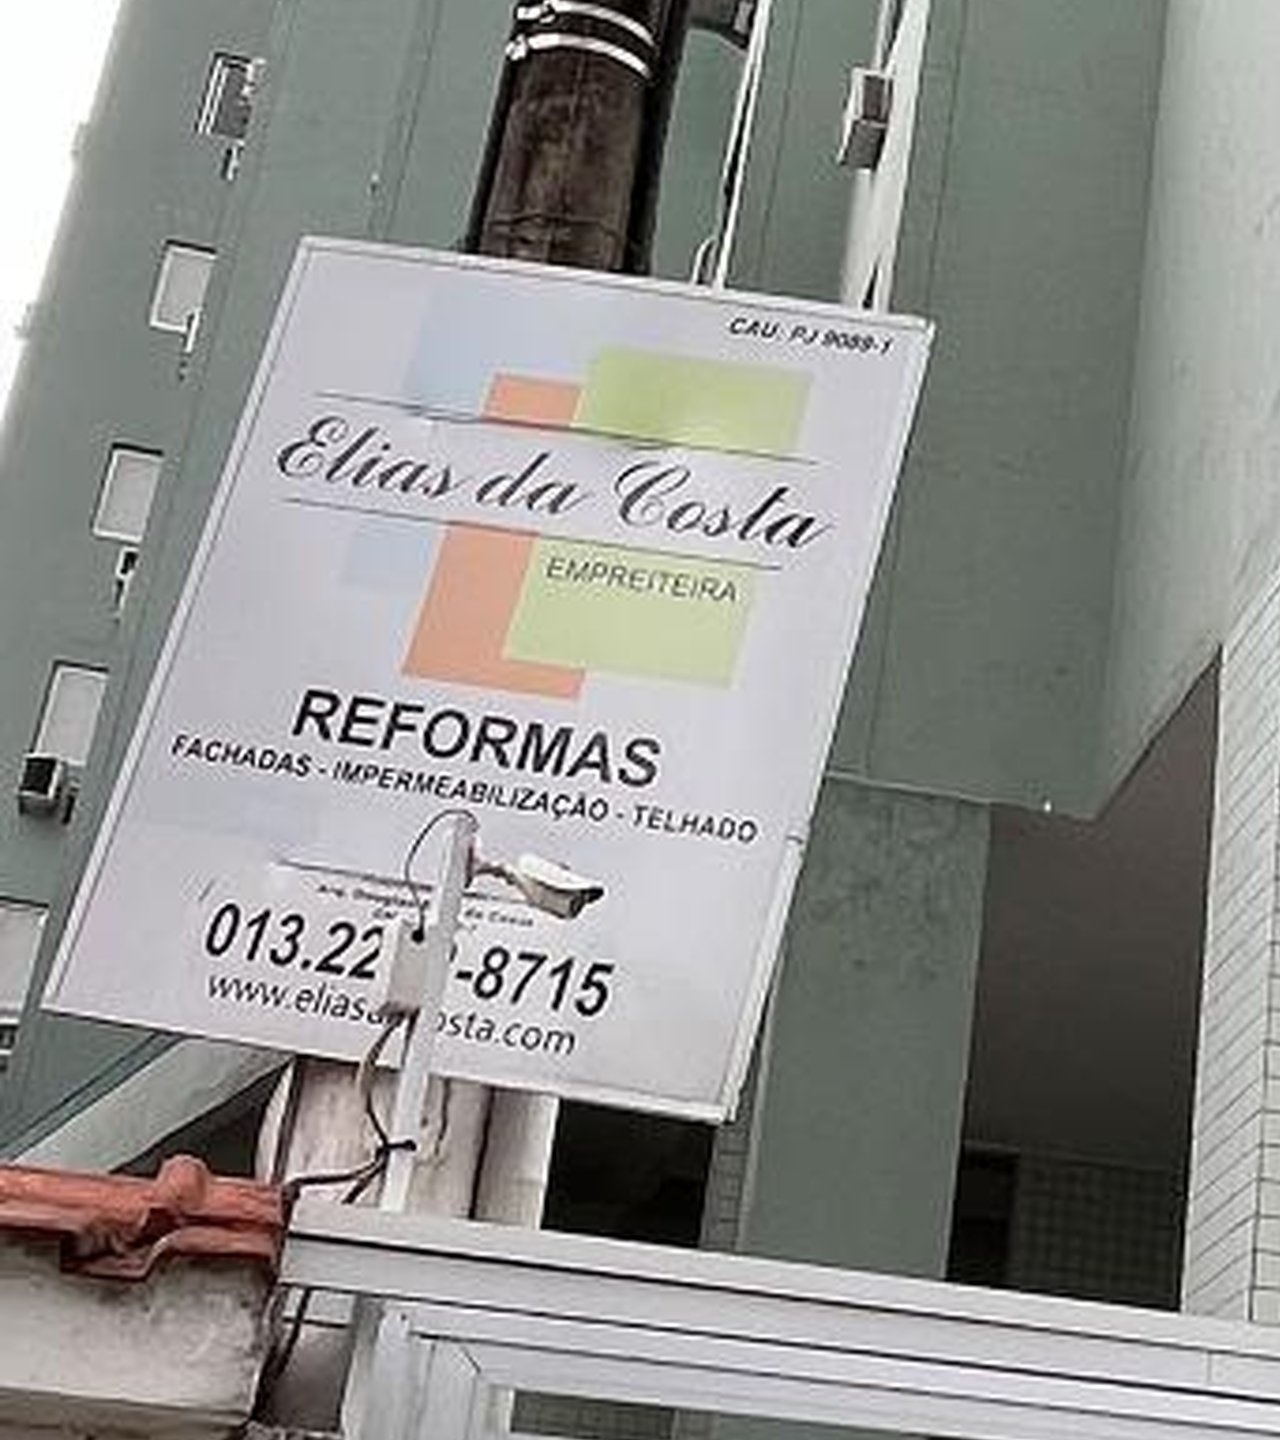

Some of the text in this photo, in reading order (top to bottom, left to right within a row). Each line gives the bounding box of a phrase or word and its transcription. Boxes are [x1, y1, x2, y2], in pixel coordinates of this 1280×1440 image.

[271, 415, 832, 550] Elias da Costa
[546, 556, 738, 603] EMPREITEIRA
[171, 734, 312, 778] FACHADAS
[332, 761, 609, 823] IMPERMEABILIZAÇÃO
[632, 805, 758, 844] TELHADO
[292, 689, 661, 788] REFORMAS
[204, 903, 615, 1016] 013.22-8715
